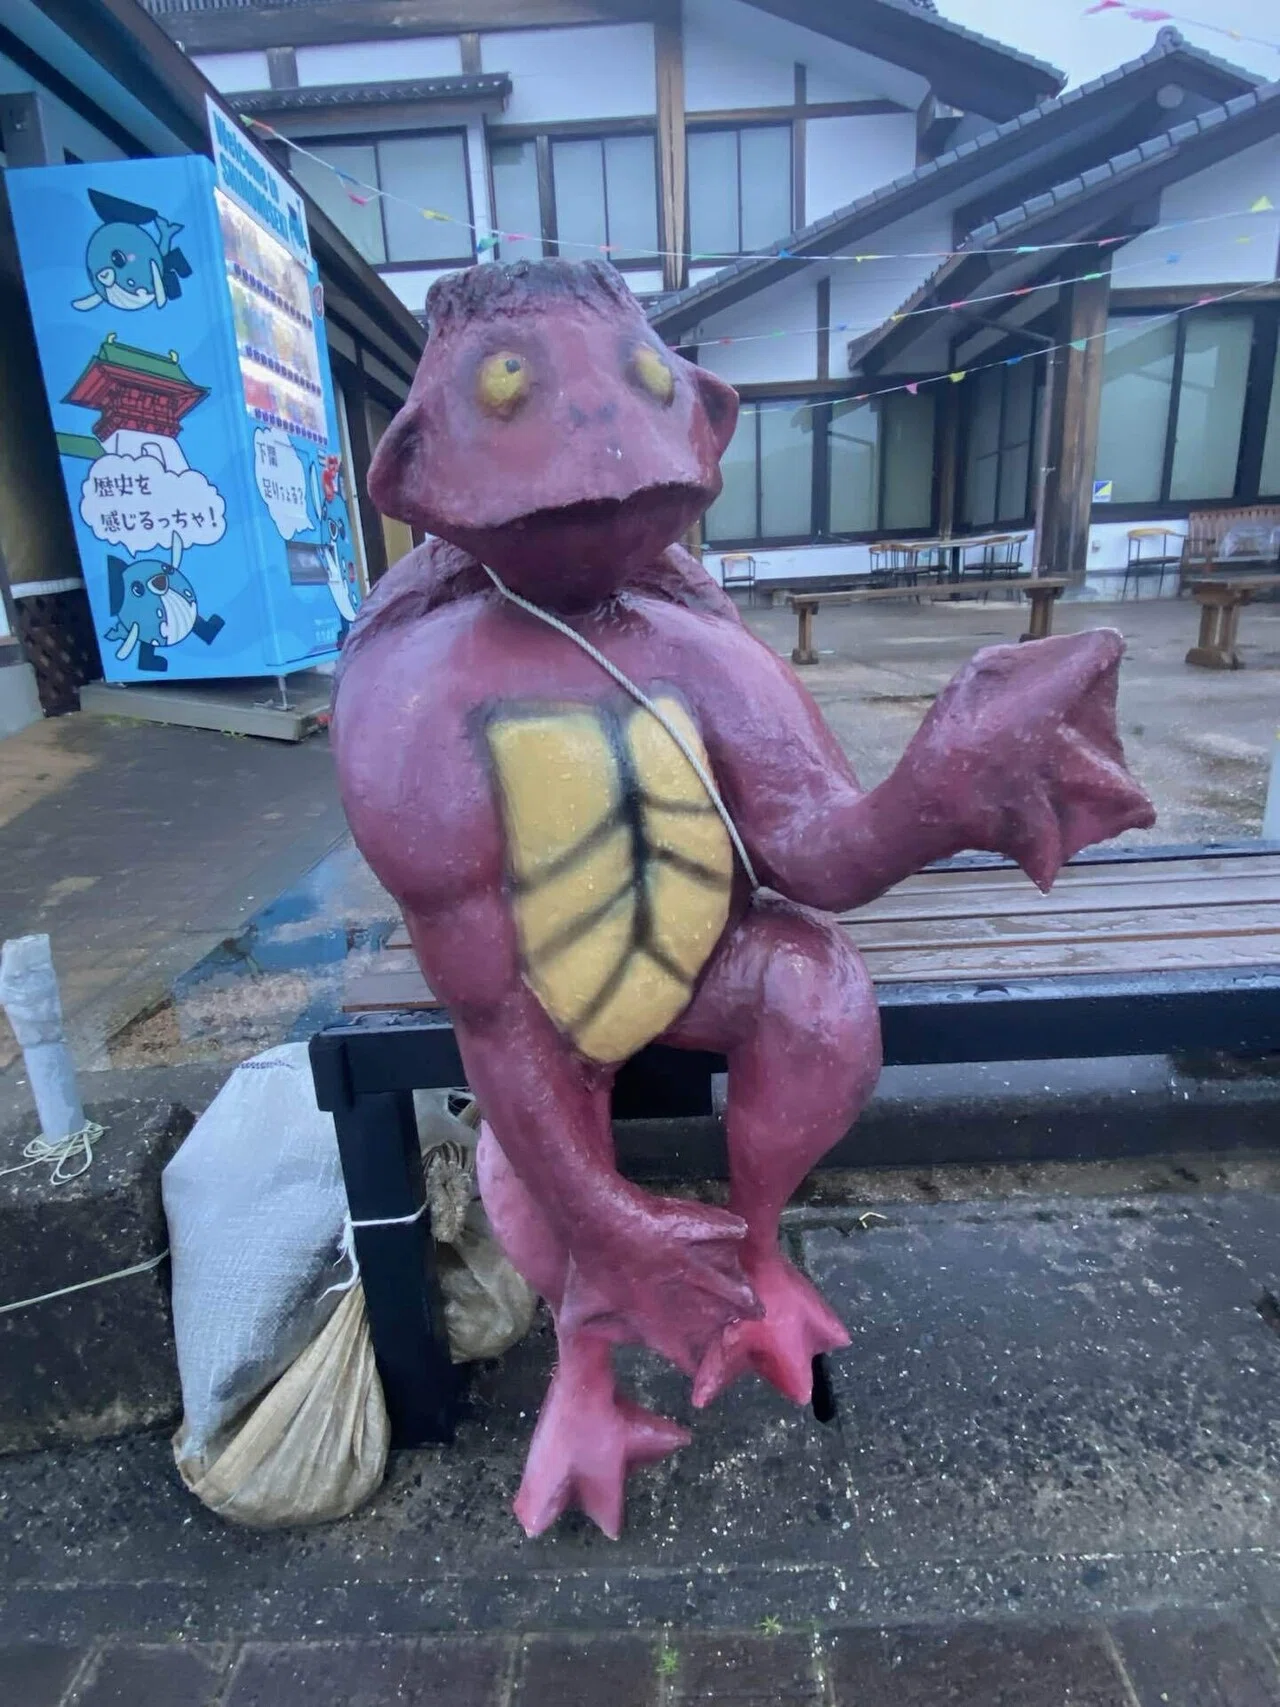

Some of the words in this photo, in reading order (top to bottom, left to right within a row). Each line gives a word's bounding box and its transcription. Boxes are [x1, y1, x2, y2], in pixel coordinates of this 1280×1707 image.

[93, 473, 152, 497] 歴史を
[101, 505, 217, 533] 感じるっちゃ!
